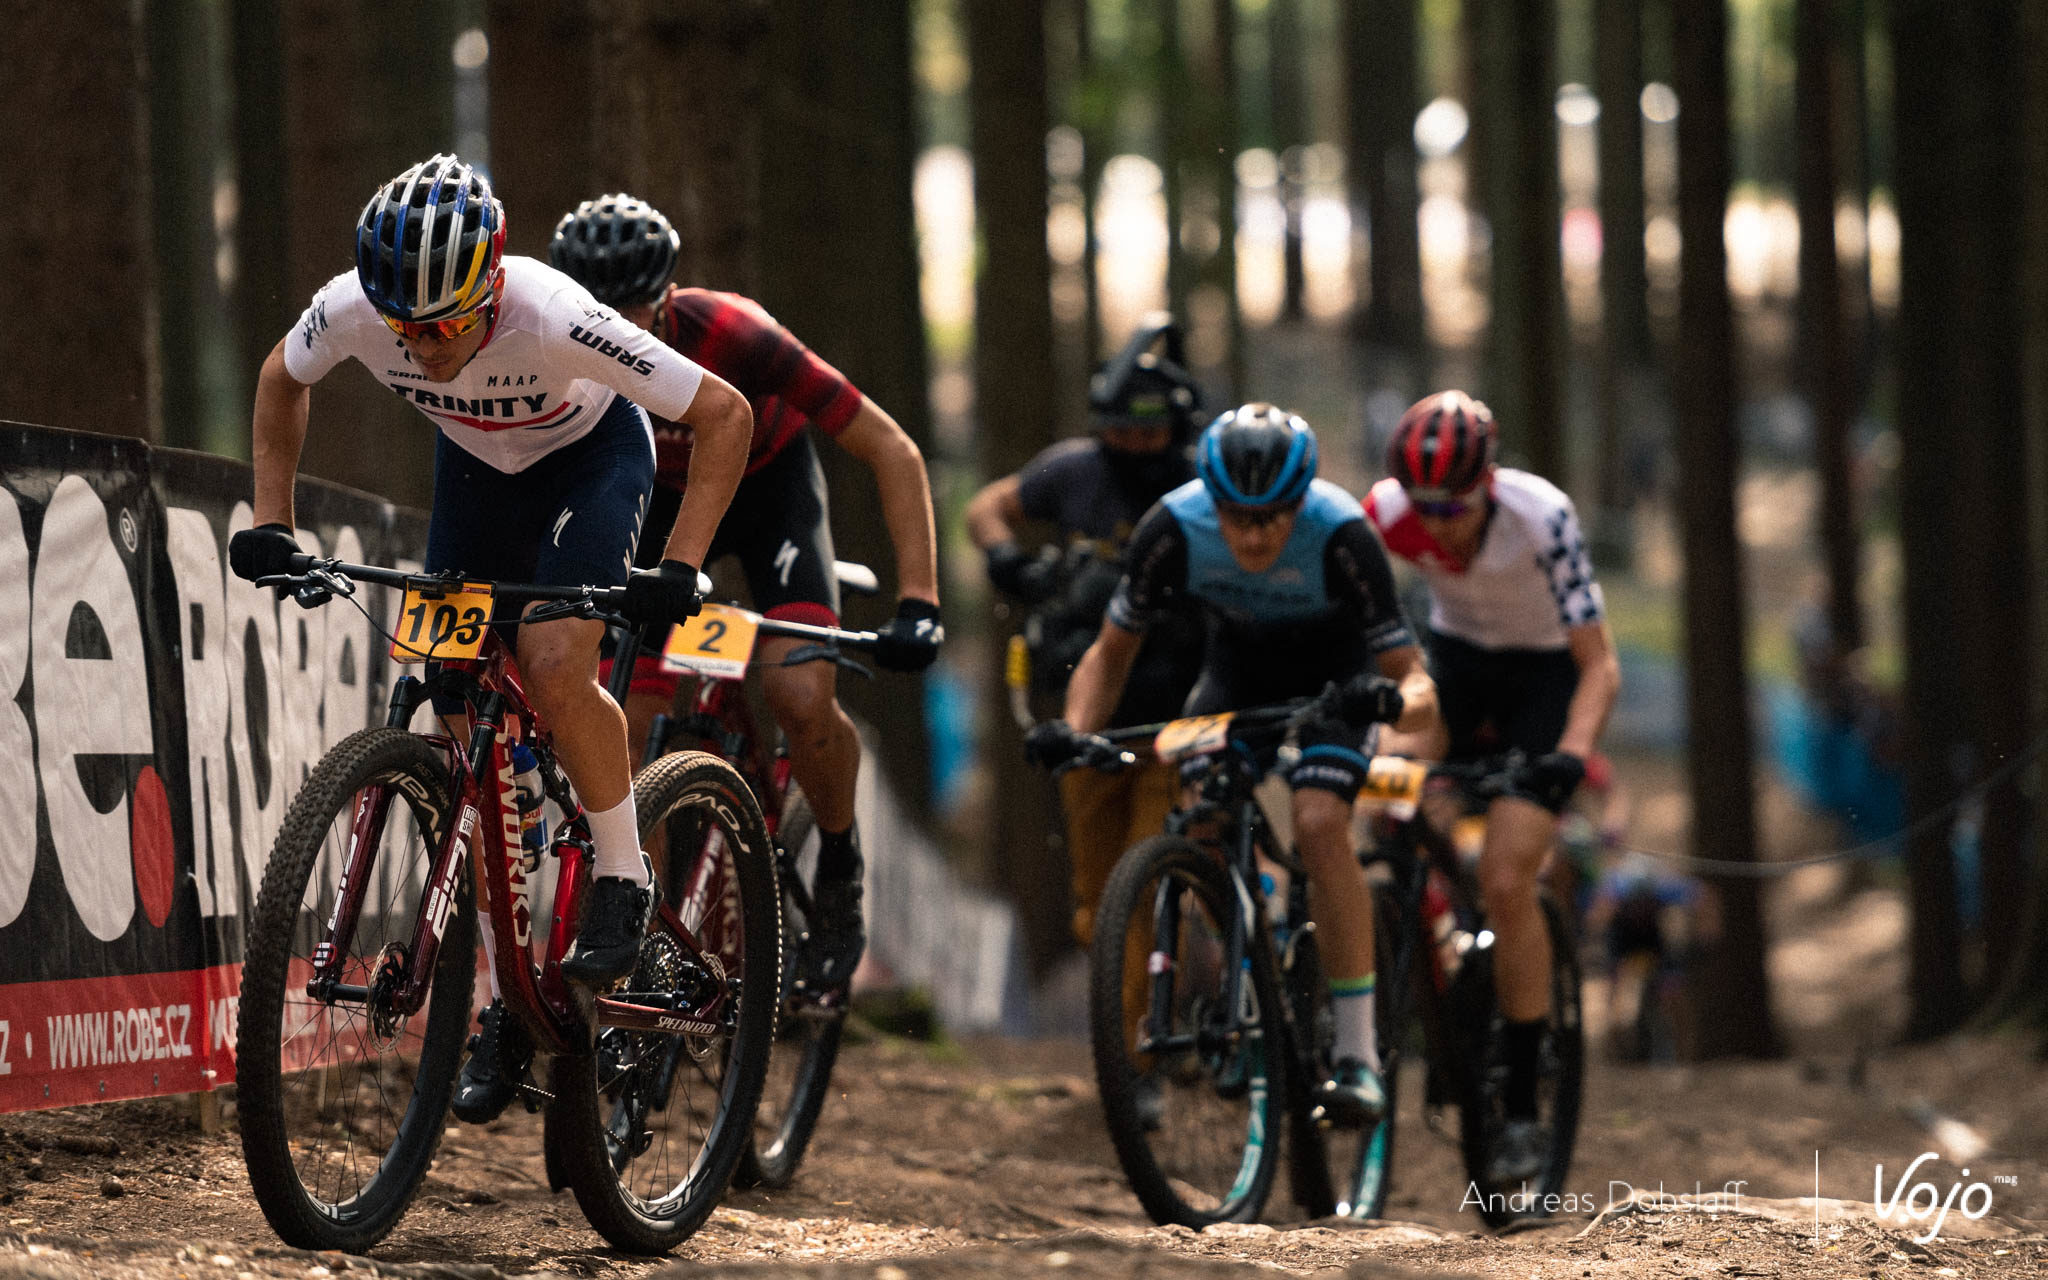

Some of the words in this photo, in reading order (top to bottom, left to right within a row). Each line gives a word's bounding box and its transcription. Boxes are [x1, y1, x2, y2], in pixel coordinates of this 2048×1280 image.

[569, 325, 656, 376] SRAM
[387, 370, 429, 381] SRA
[487, 374, 538, 387] MAAP
[390, 383, 548, 418] TRINITY
[407, 602, 486, 646] 103
[697, 618, 727, 653] 2
[47, 1004, 192, 1070] WWW.ROBE.CZ
[654, 1016, 717, 1034] SPECIALIZED
